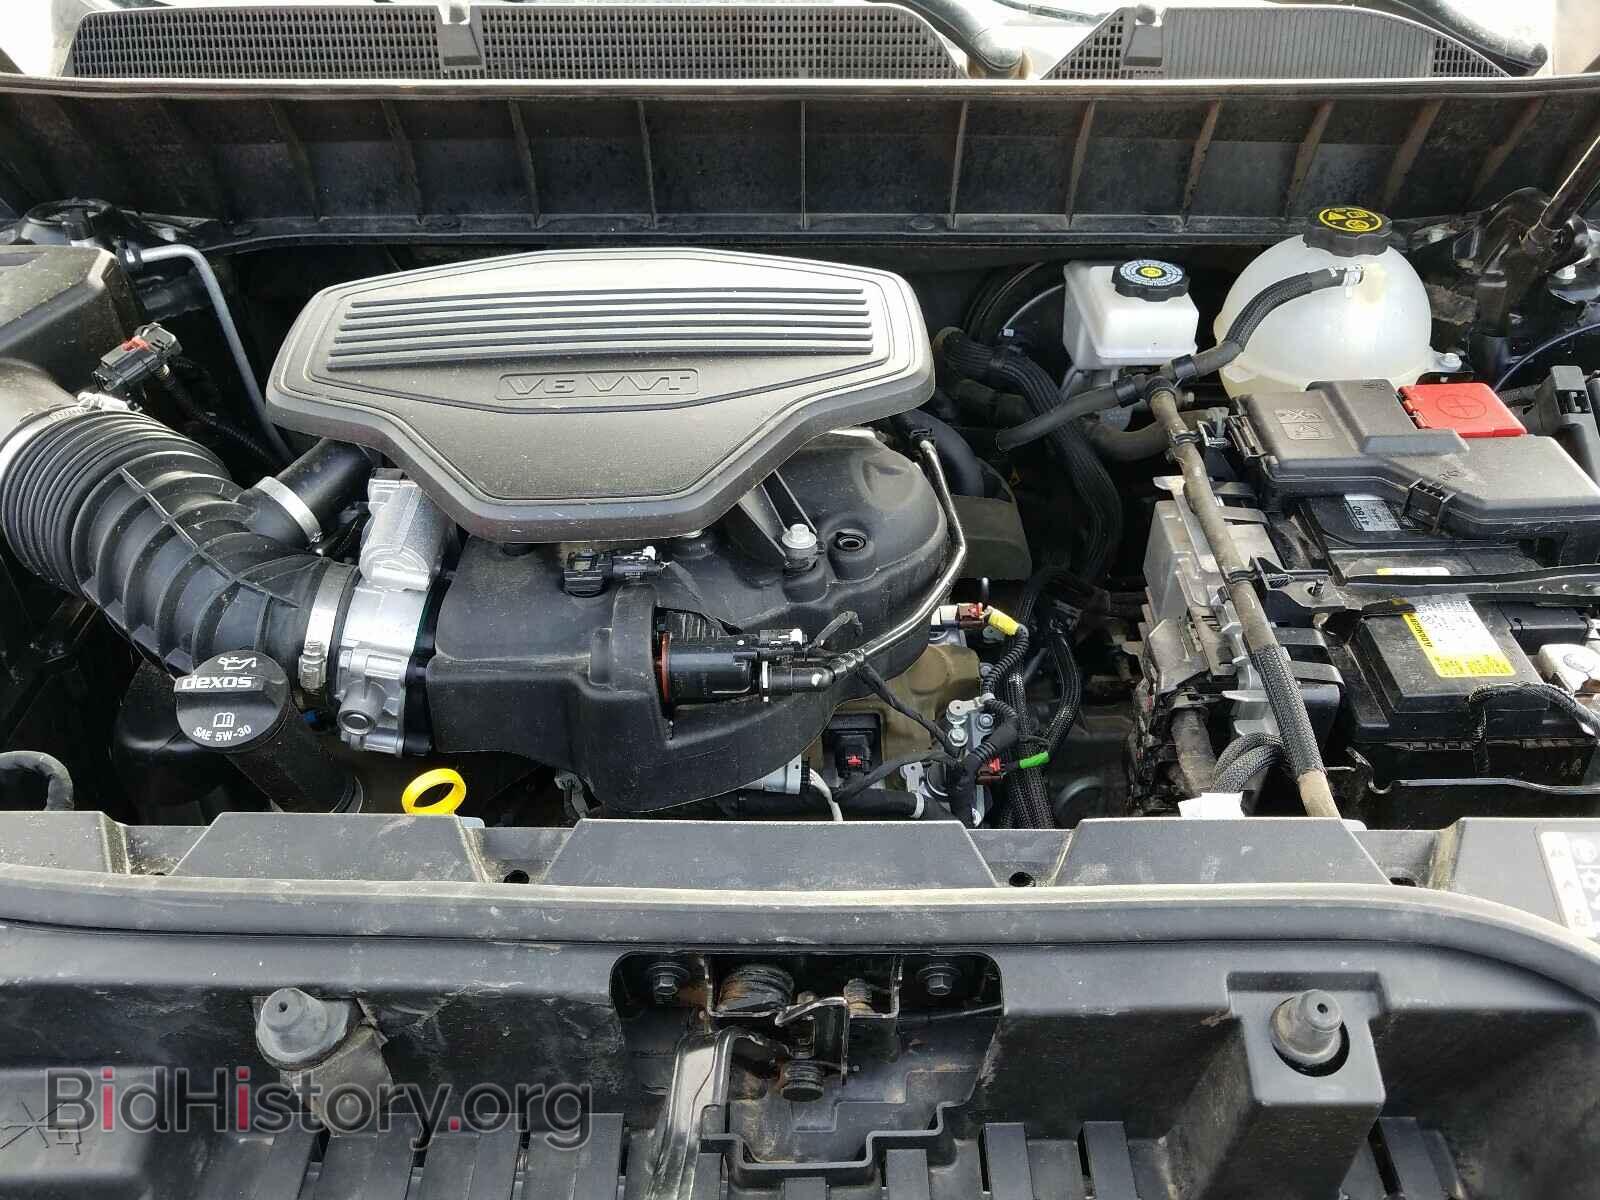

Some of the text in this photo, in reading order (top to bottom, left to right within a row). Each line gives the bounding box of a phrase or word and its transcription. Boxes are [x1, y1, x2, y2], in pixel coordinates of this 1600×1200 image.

[506, 375, 691, 395] V6 VVT
[182, 675, 253, 689] dexos
[193, 724, 252, 742] SAE 5W-30
